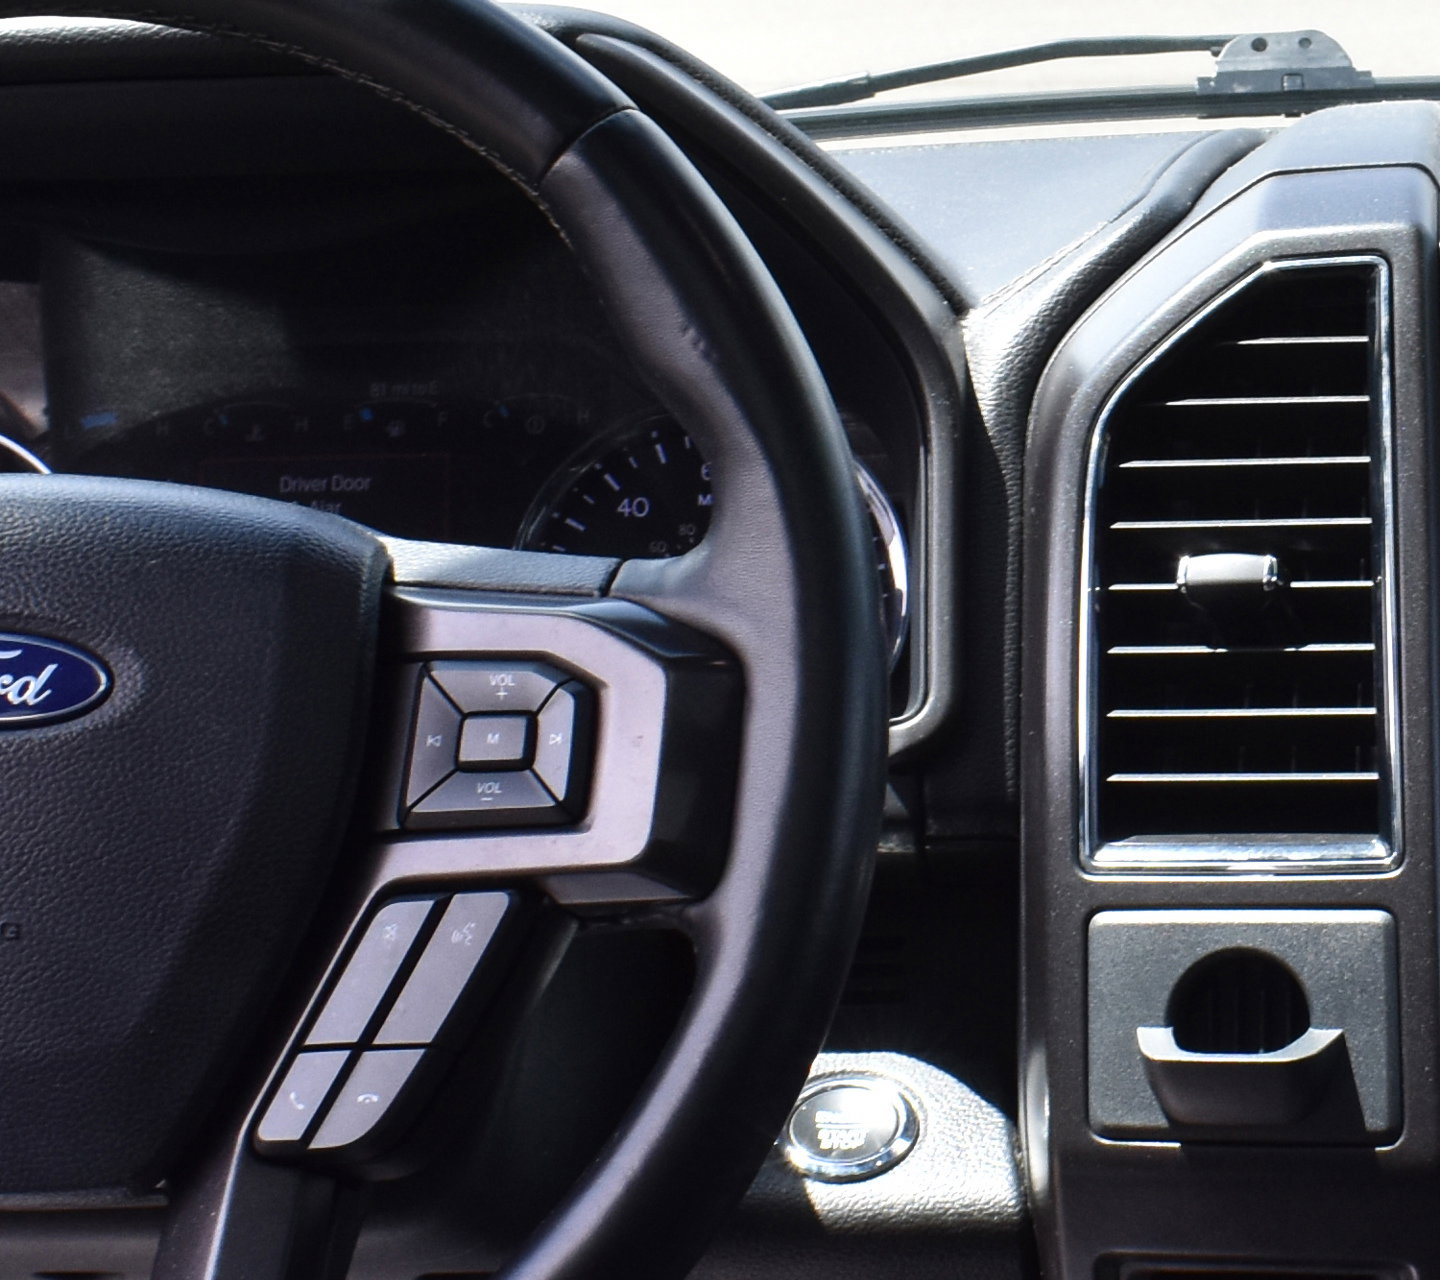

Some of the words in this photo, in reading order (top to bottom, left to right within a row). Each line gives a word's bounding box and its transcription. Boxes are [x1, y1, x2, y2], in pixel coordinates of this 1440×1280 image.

[279, 476, 327, 493] Driver
[331, 475, 372, 493] Door
[616, 497, 652, 518] 40
[489, 674, 515, 686] VOL
[487, 733, 499, 745] M
[476, 781, 503, 795] VOL
